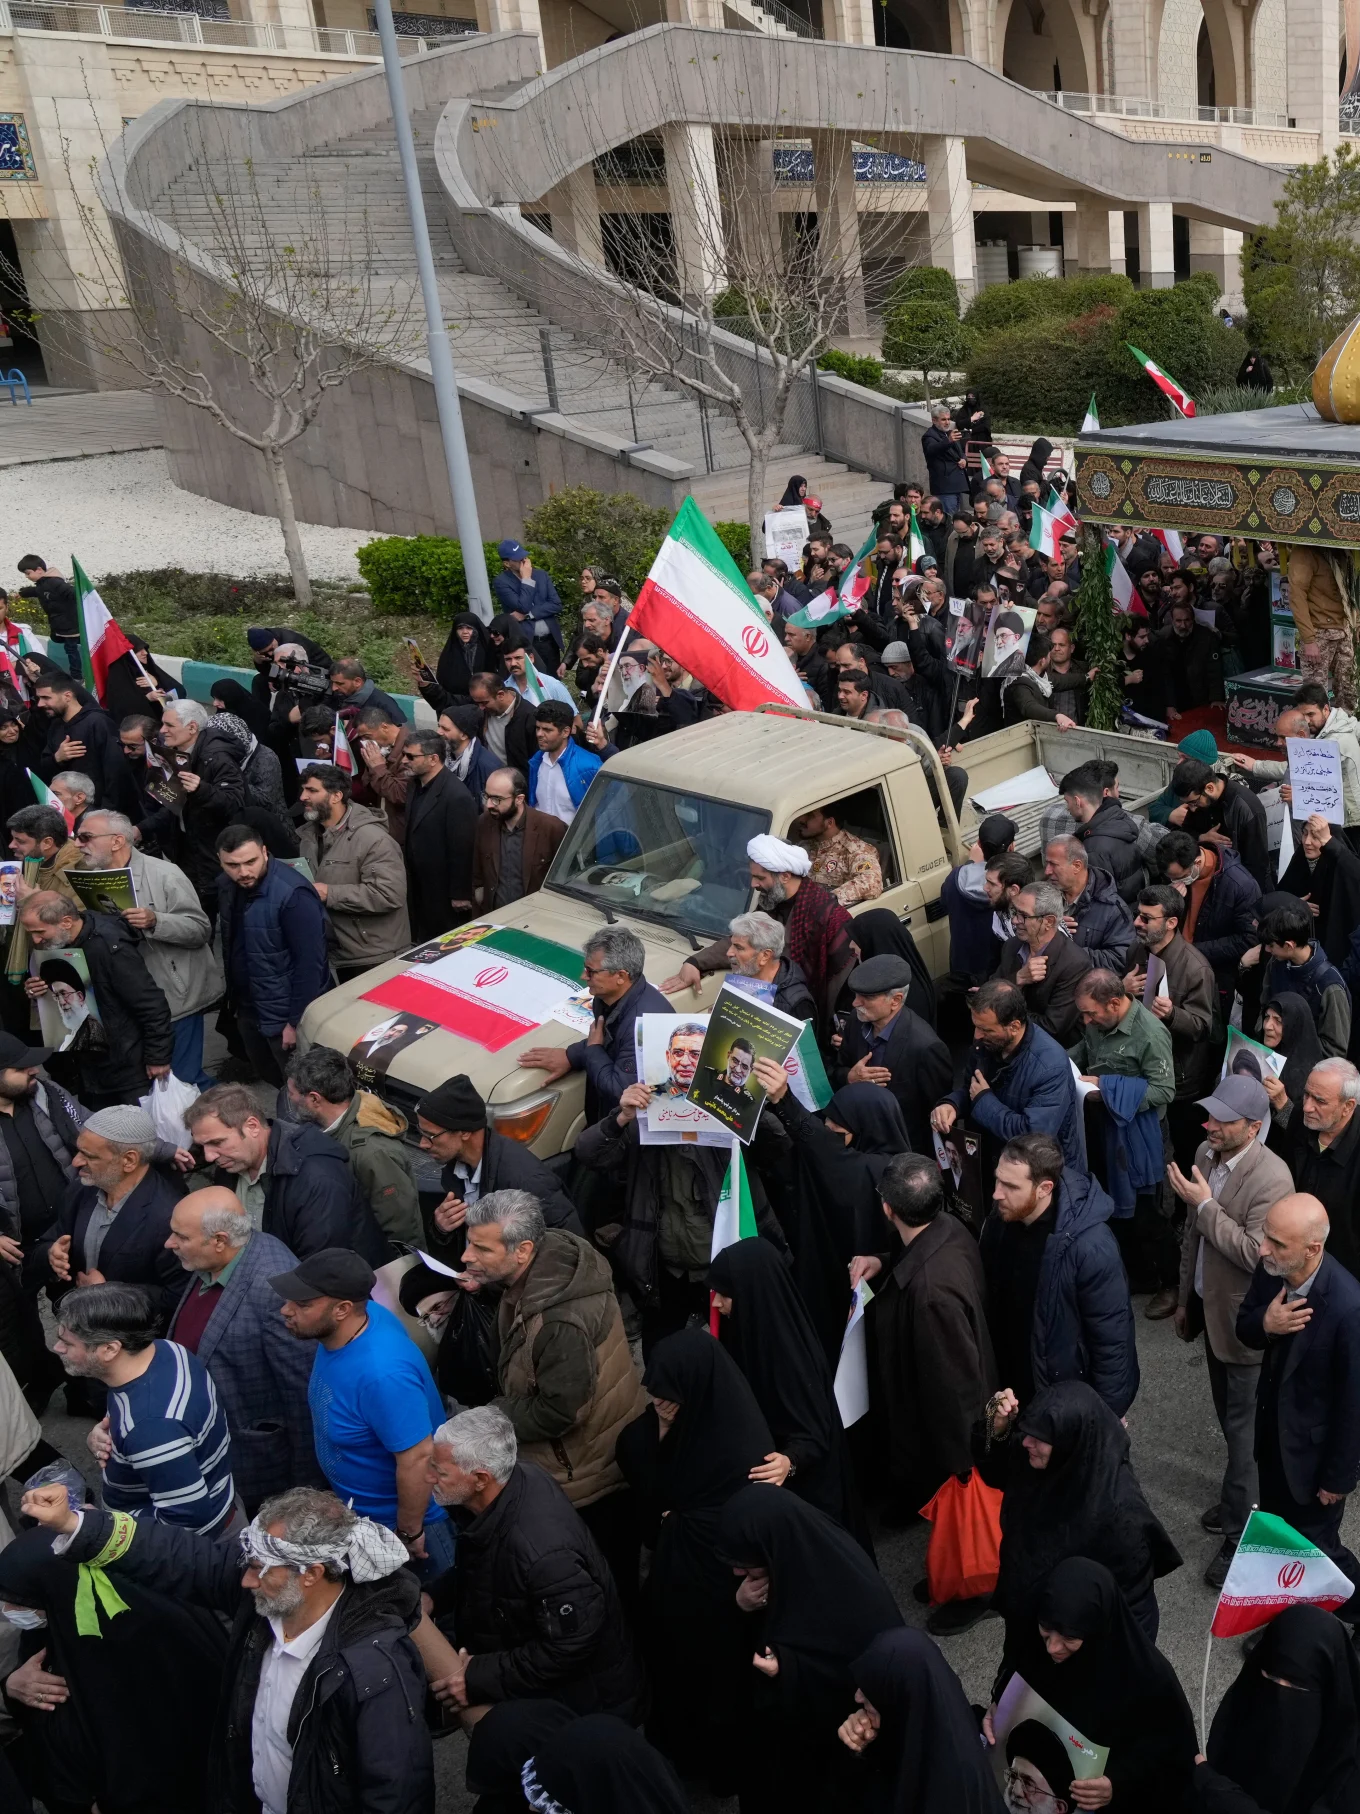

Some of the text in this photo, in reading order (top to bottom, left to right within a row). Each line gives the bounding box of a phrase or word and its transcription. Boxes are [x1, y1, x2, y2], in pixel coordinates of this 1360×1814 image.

[1306, 748, 1319, 760] مقدم
[1320, 748, 1335, 759] خط
[1315, 765, 1333, 776] خیلی
[1303, 794, 1321, 805] دشمن
